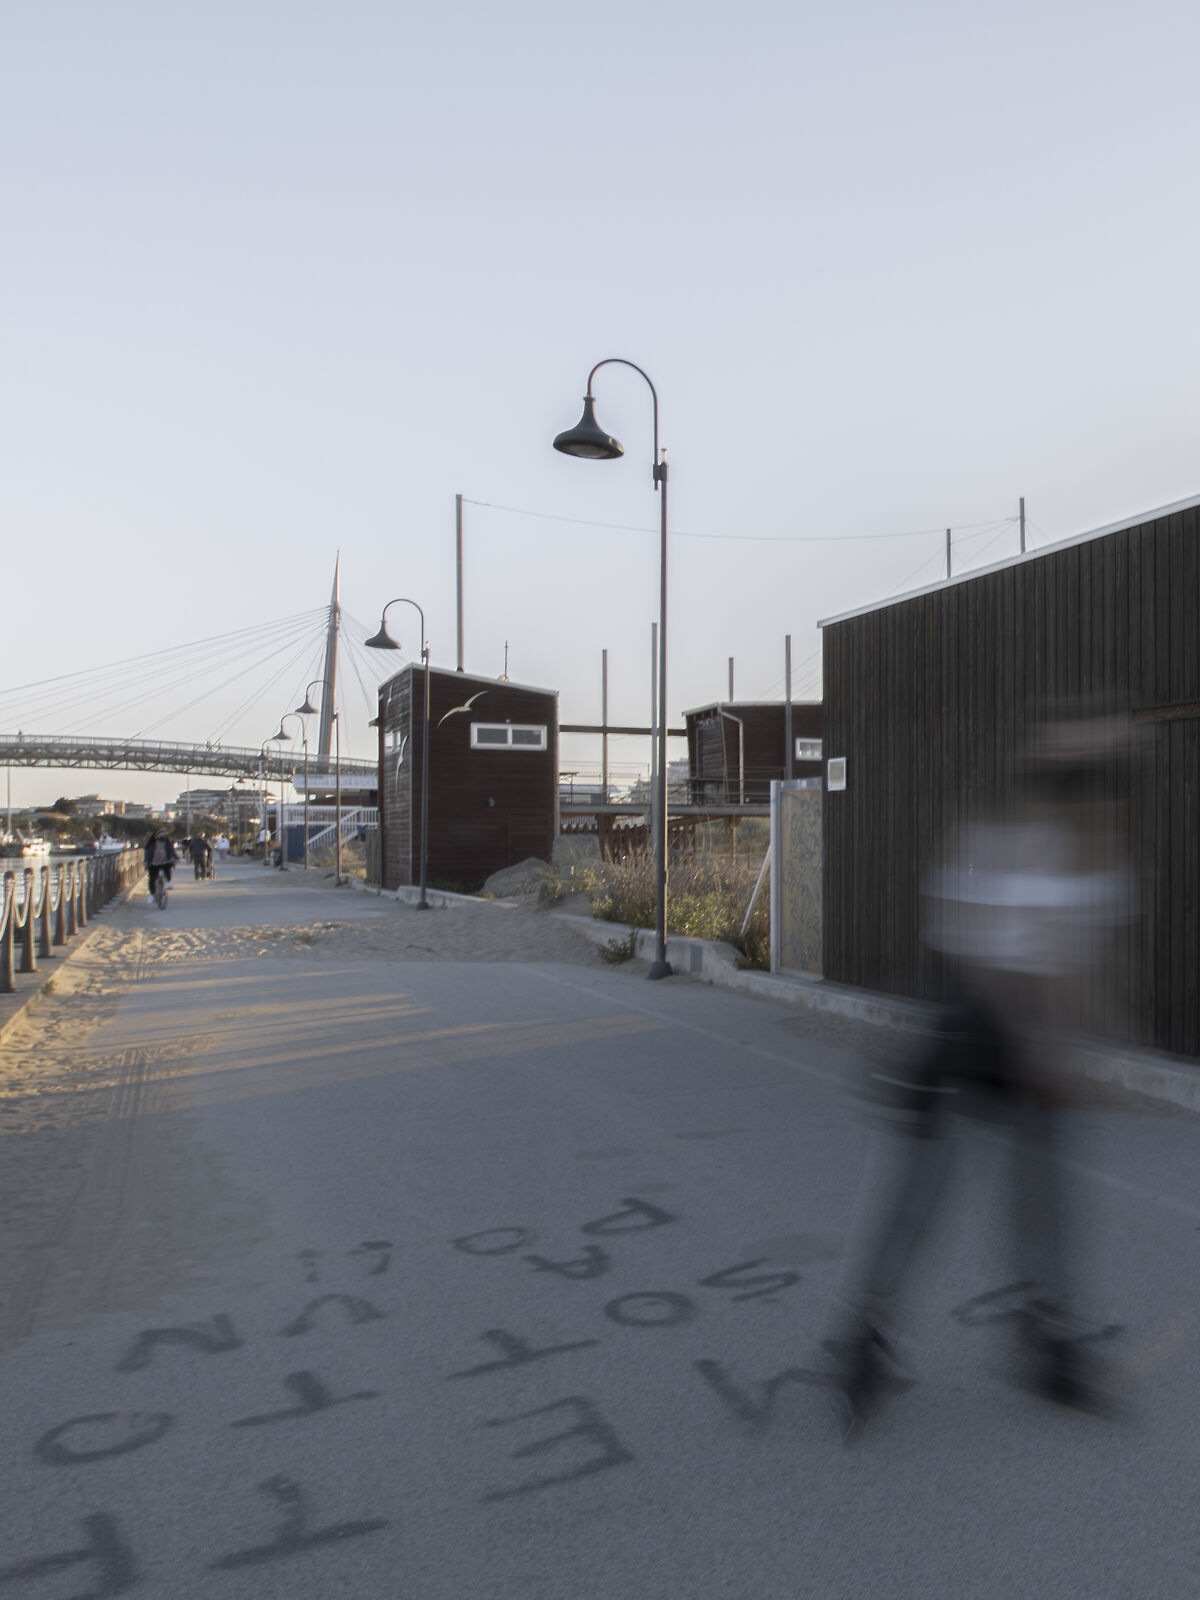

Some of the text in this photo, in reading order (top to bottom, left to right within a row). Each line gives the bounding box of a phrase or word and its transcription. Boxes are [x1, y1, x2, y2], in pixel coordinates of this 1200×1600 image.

[33, 1256, 803, 1464] SOTTO
[113, 1244, 612, 1374] A UN
